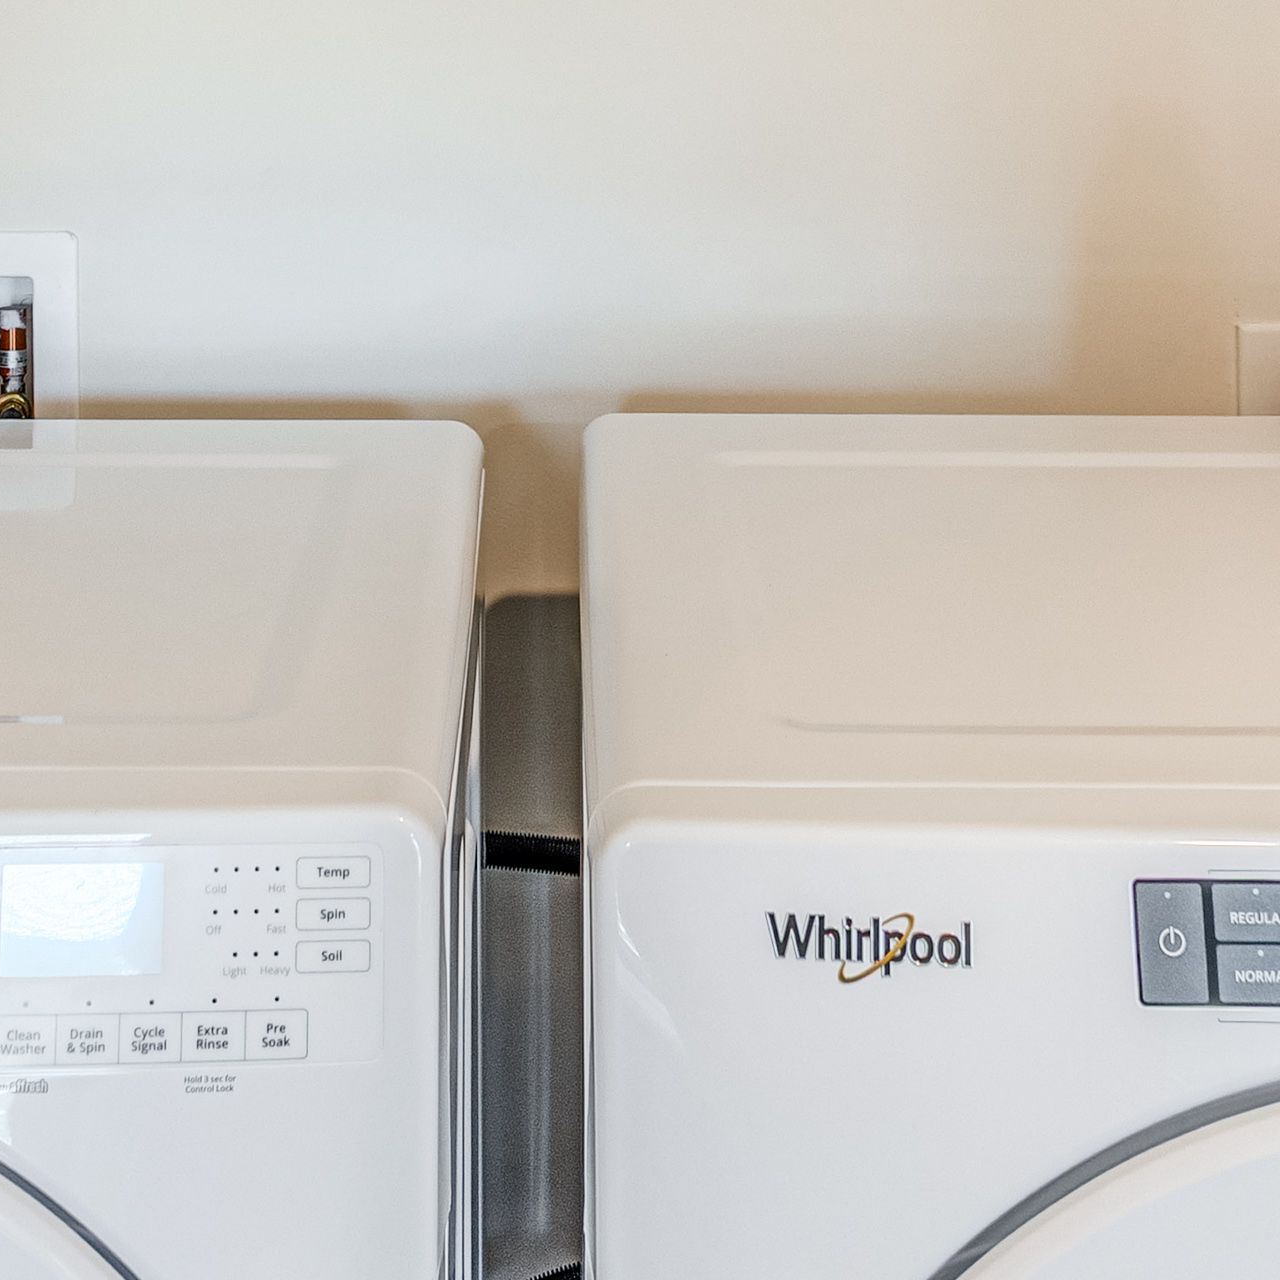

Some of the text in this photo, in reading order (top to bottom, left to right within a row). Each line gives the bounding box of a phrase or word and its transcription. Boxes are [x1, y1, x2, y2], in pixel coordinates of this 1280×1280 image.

[316, 865, 351, 880] Temp
[205, 883, 287, 895] Cold Hot
[319, 907, 347, 923] Spin
[205, 924, 287, 936] Off Fast
[765, 911, 973, 978] Whirlpool
[320, 949, 344, 964] Soil
[222, 964, 291, 979] Light Heavy
[6, 1028, 41, 1042] Clean
[69, 1026, 104, 1041] Drain
[133, 1025, 166, 1041] Cycle
[196, 1024, 229, 1038] Extra
[266, 1022, 287, 1036] Pre
[0, 1041, 47, 1056] Washer
[66, 1040, 106, 1056] & Spin
[130, 1038, 168, 1054] Signal
[196, 1037, 229, 1051] Rinse
[261, 1035, 291, 1049] Soak
[184, 1075, 202, 1083] Hold
[185, 1084, 214, 1093] Control
